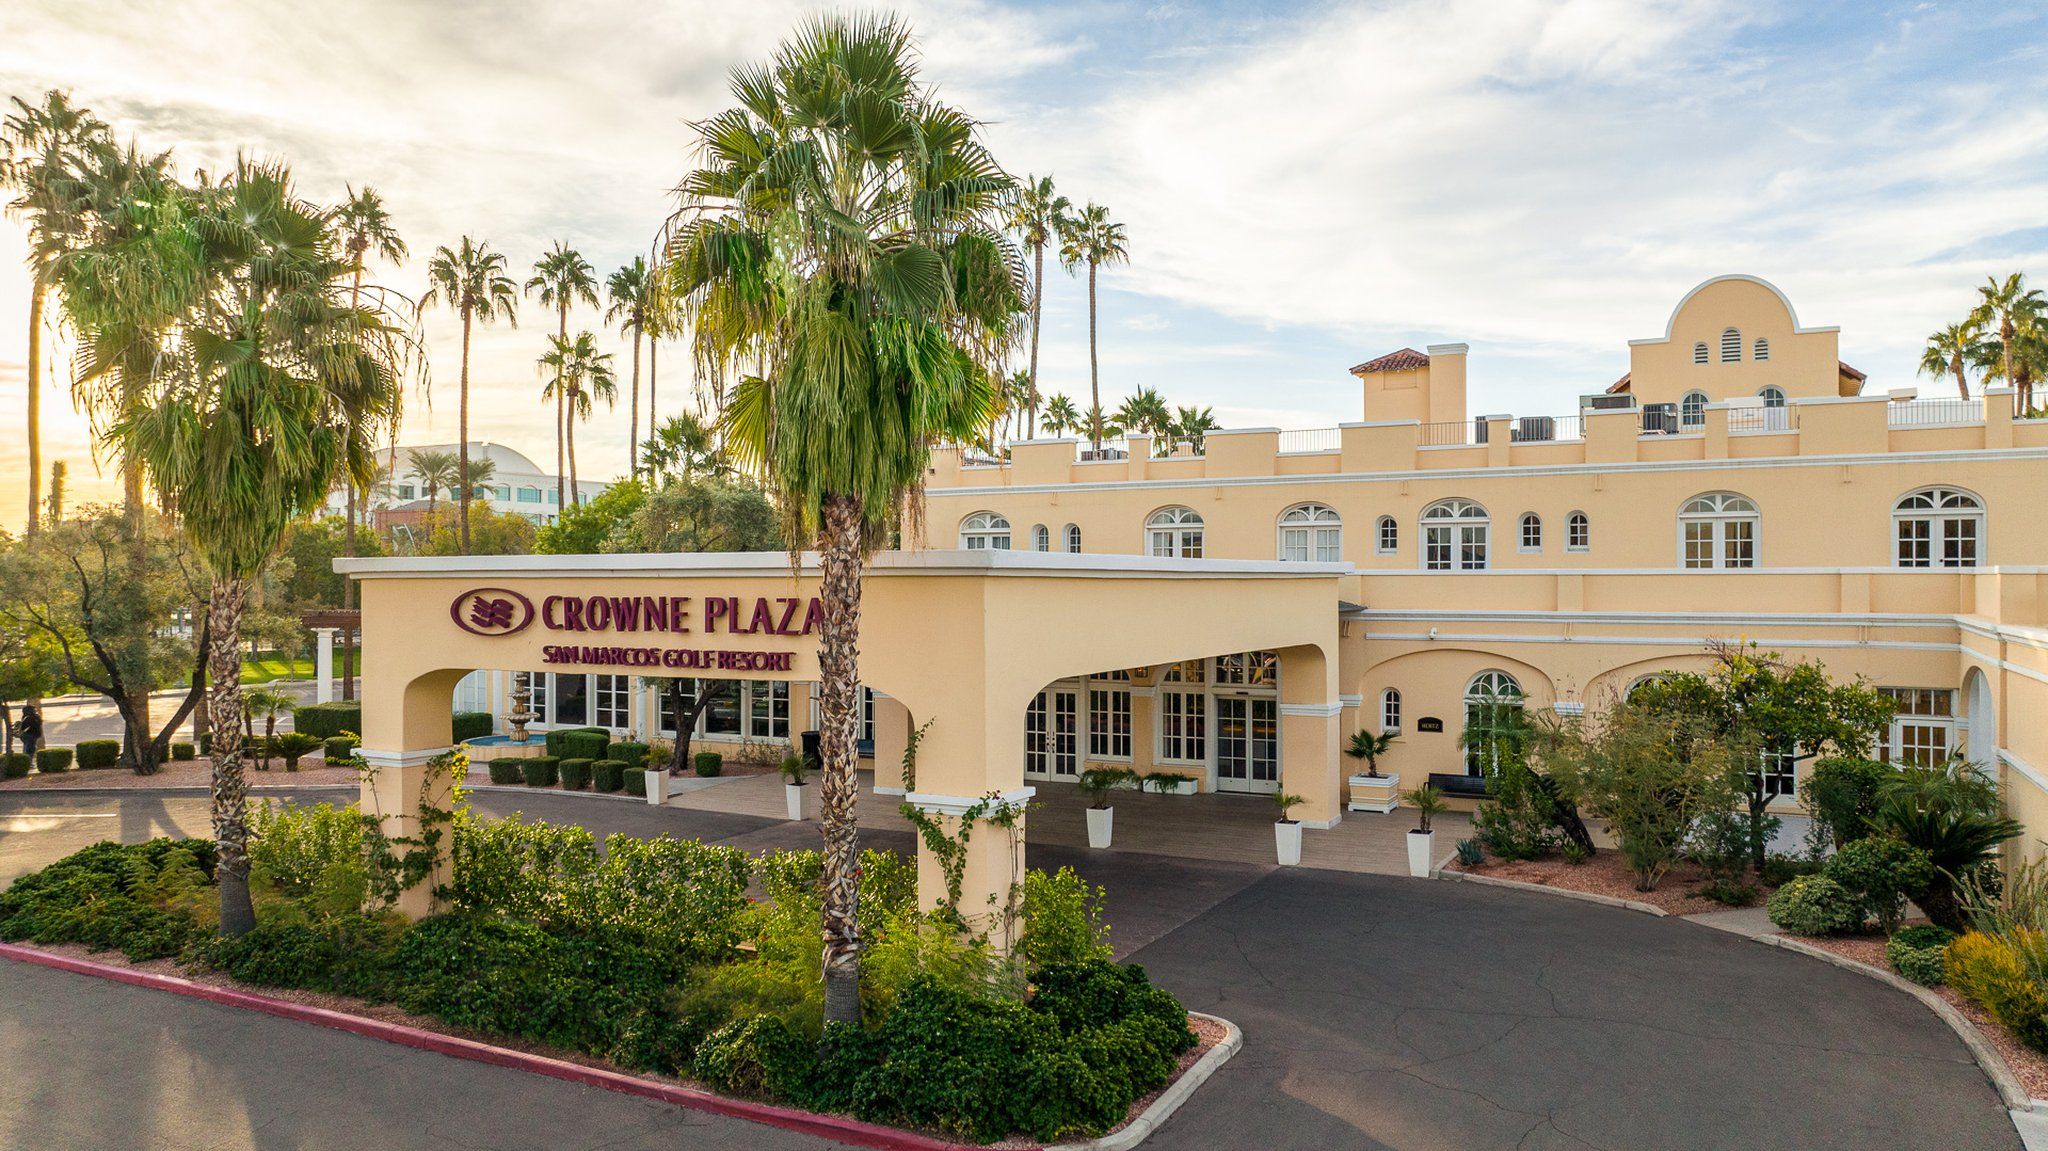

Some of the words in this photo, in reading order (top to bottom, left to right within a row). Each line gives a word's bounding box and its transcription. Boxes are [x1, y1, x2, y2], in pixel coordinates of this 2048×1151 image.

[542, 595, 690, 633] CROWNE
[705, 597, 823, 635] PLAZA
[543, 645, 578, 664] SAN
[581, 646, 661, 666] MARCOS
[662, 648, 715, 669] GOLF
[717, 650, 796, 671] RESORT
